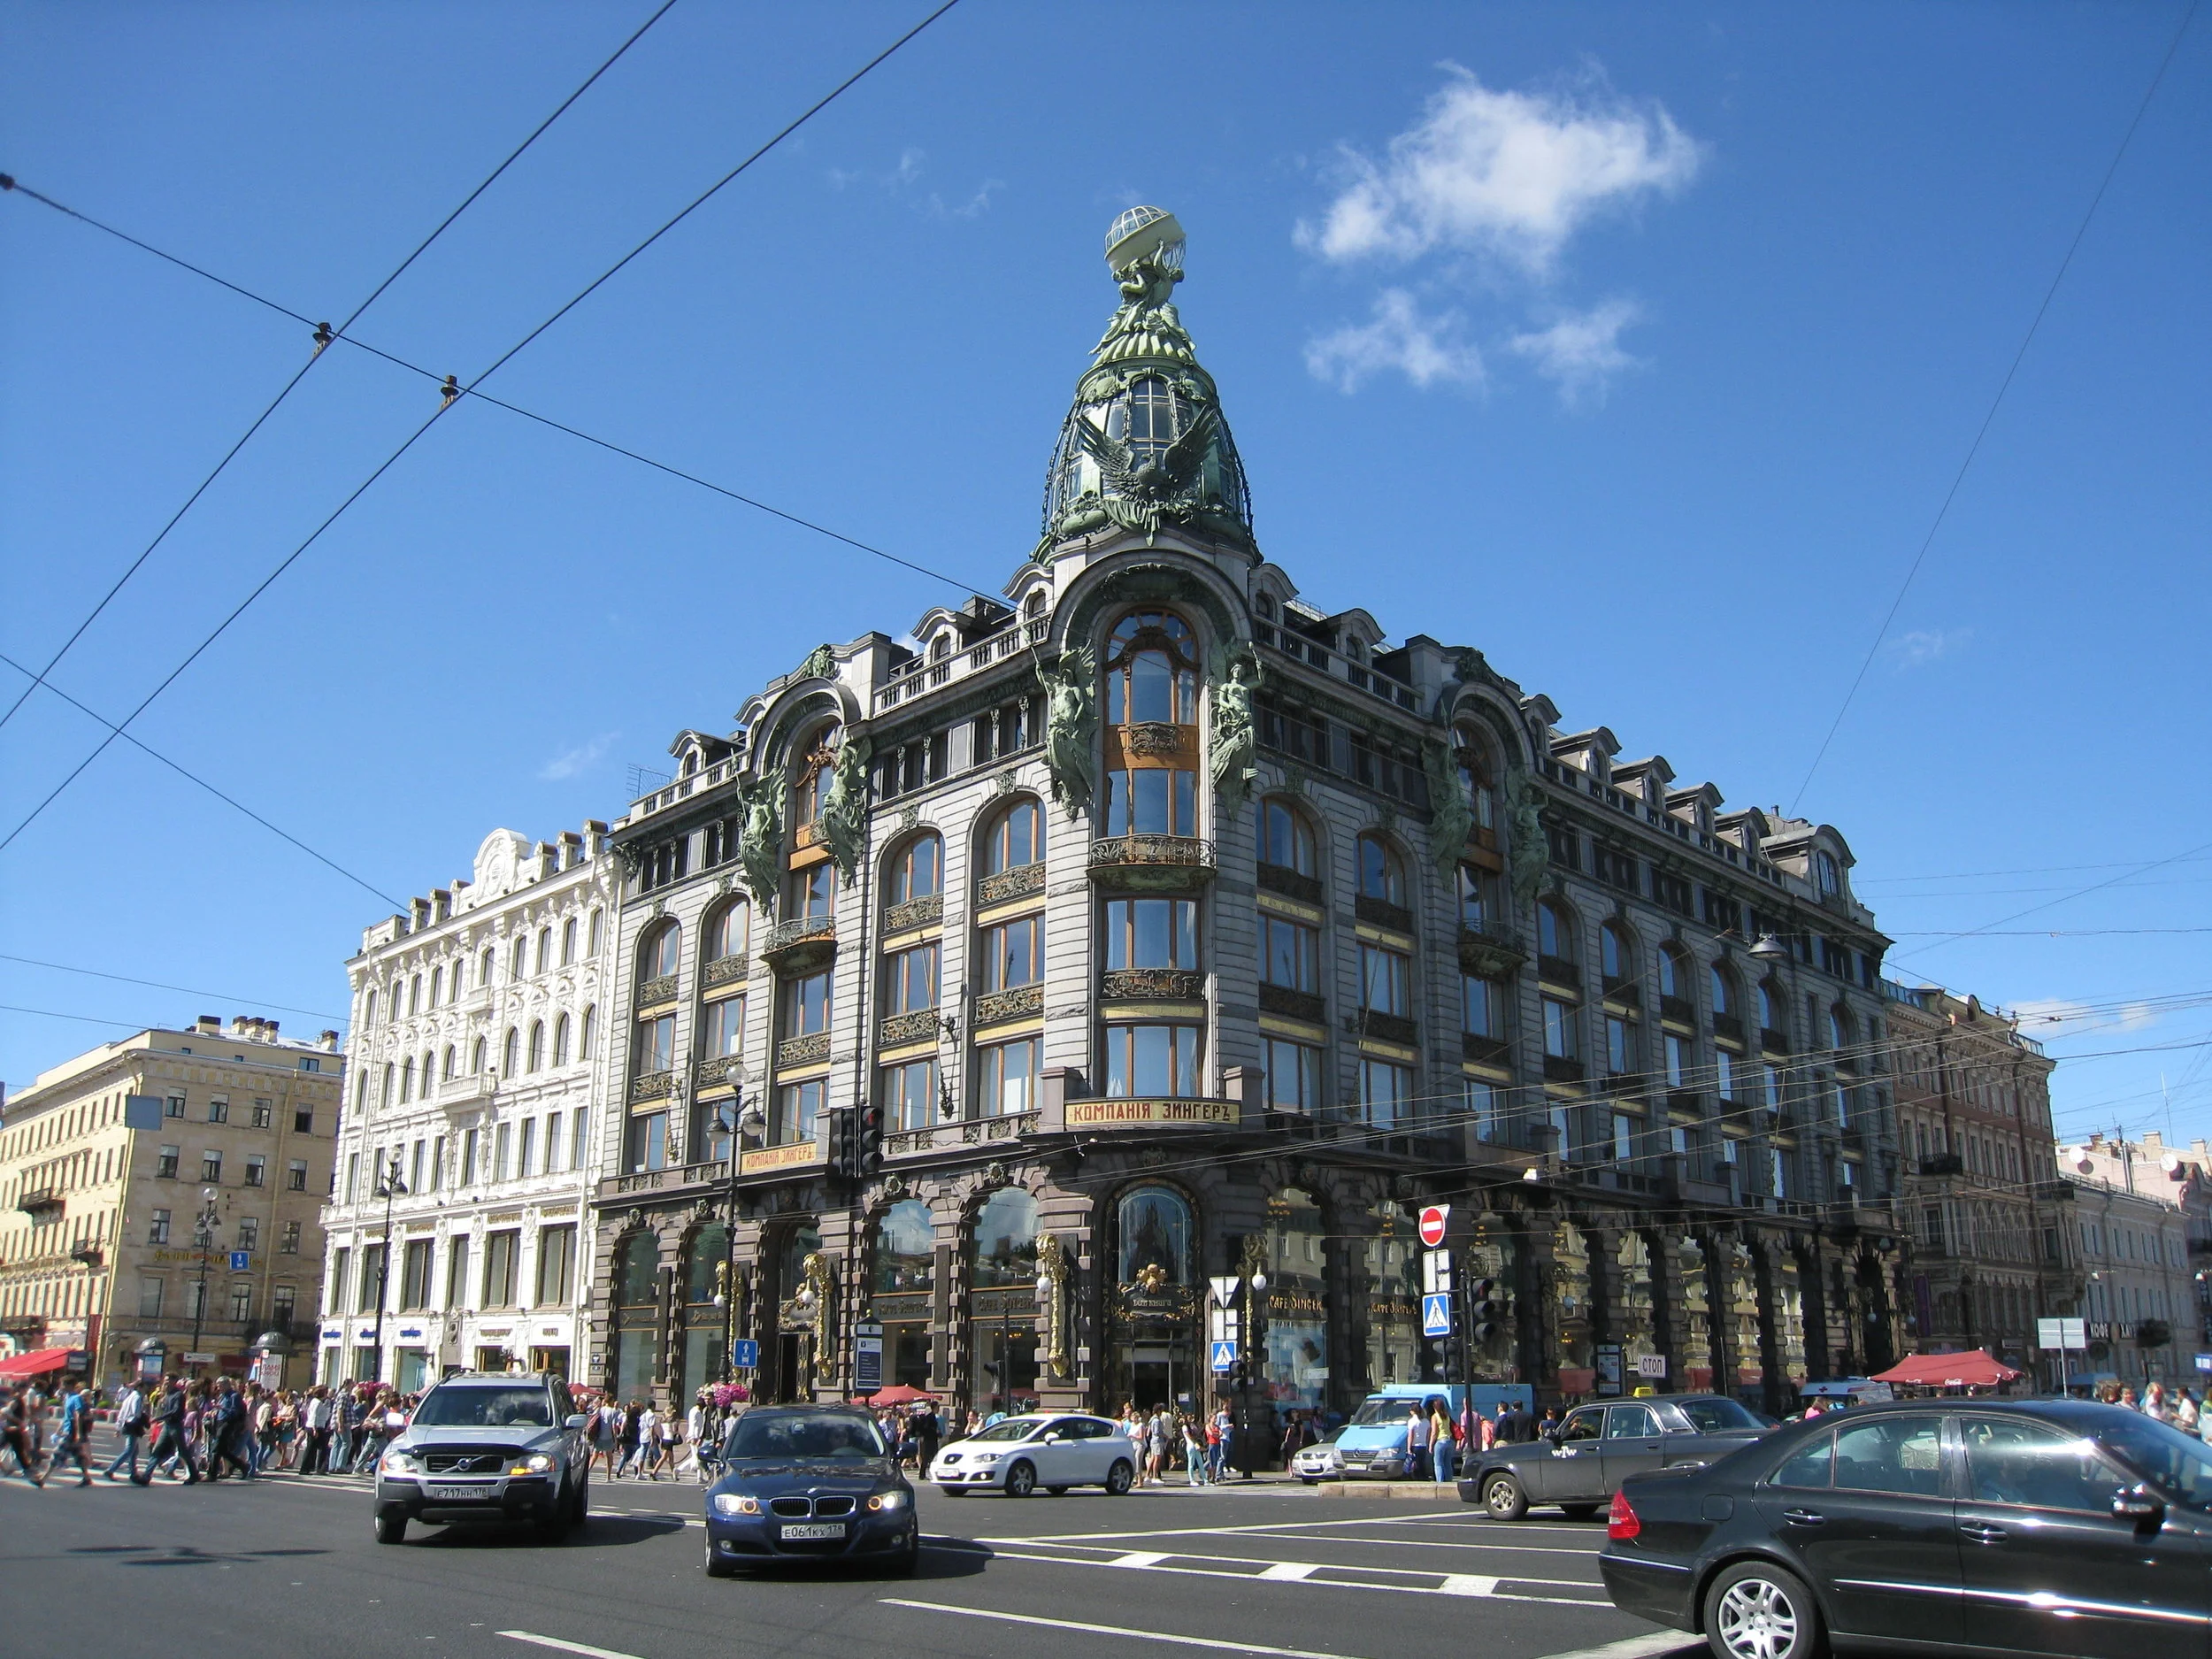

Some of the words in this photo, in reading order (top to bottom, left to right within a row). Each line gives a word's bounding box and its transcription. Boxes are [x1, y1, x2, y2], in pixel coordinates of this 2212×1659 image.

[1074, 1102, 1150, 1121] КОМПАНІЯ
[1163, 1102, 1230, 1121] ЗИНГЕРЪ
[1642, 1358, 1663, 1374] СТОП
